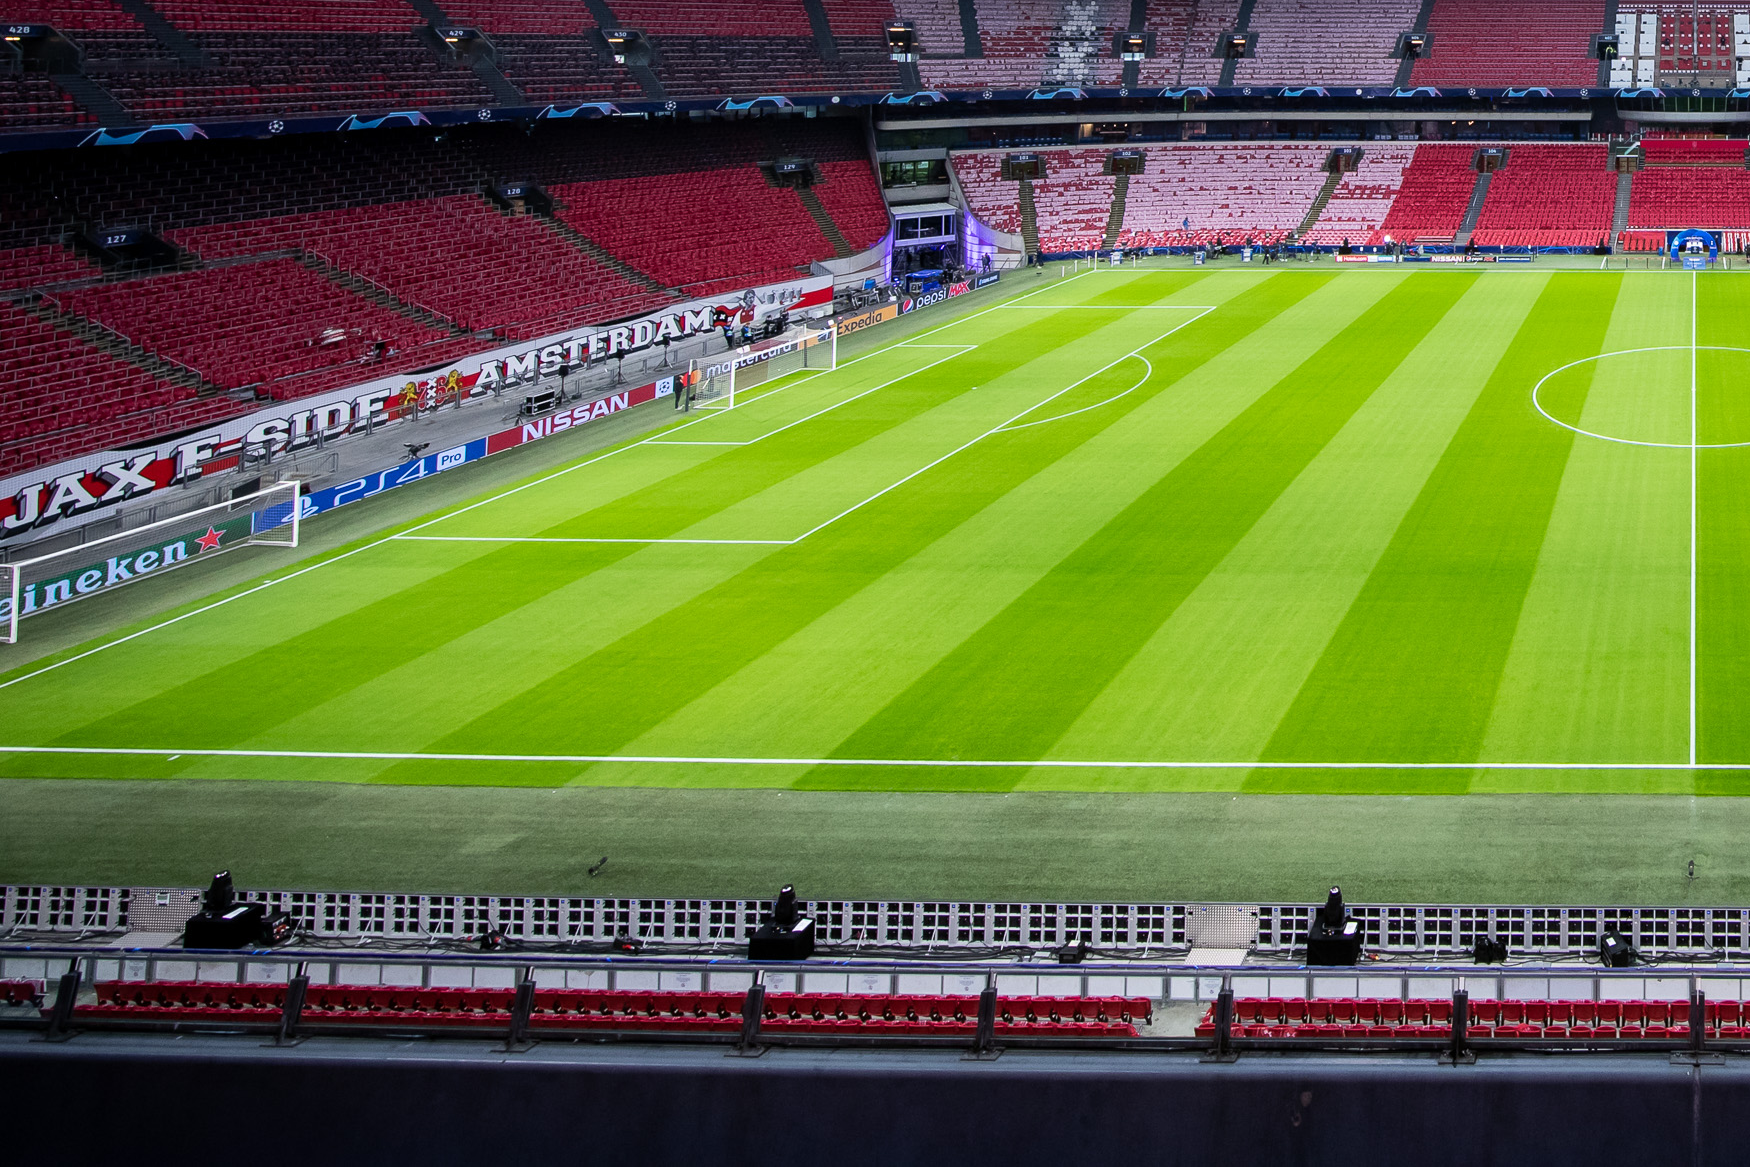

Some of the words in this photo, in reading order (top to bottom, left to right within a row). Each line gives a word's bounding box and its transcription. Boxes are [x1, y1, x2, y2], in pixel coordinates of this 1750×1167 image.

[107, 234, 126, 244] 127
[916, 288, 946, 309] pepsi
[948, 279, 972, 298] MAX
[837, 311, 882, 335] Expedia
[469, 305, 716, 396] AMSTERDAM
[706, 339, 792, 378] mastercard
[172, 388, 392, 485] F-SIDE
[522, 392, 630, 443] NISSAN
[333, 458, 429, 507] PS4
[441, 452, 462, 466] Pro
